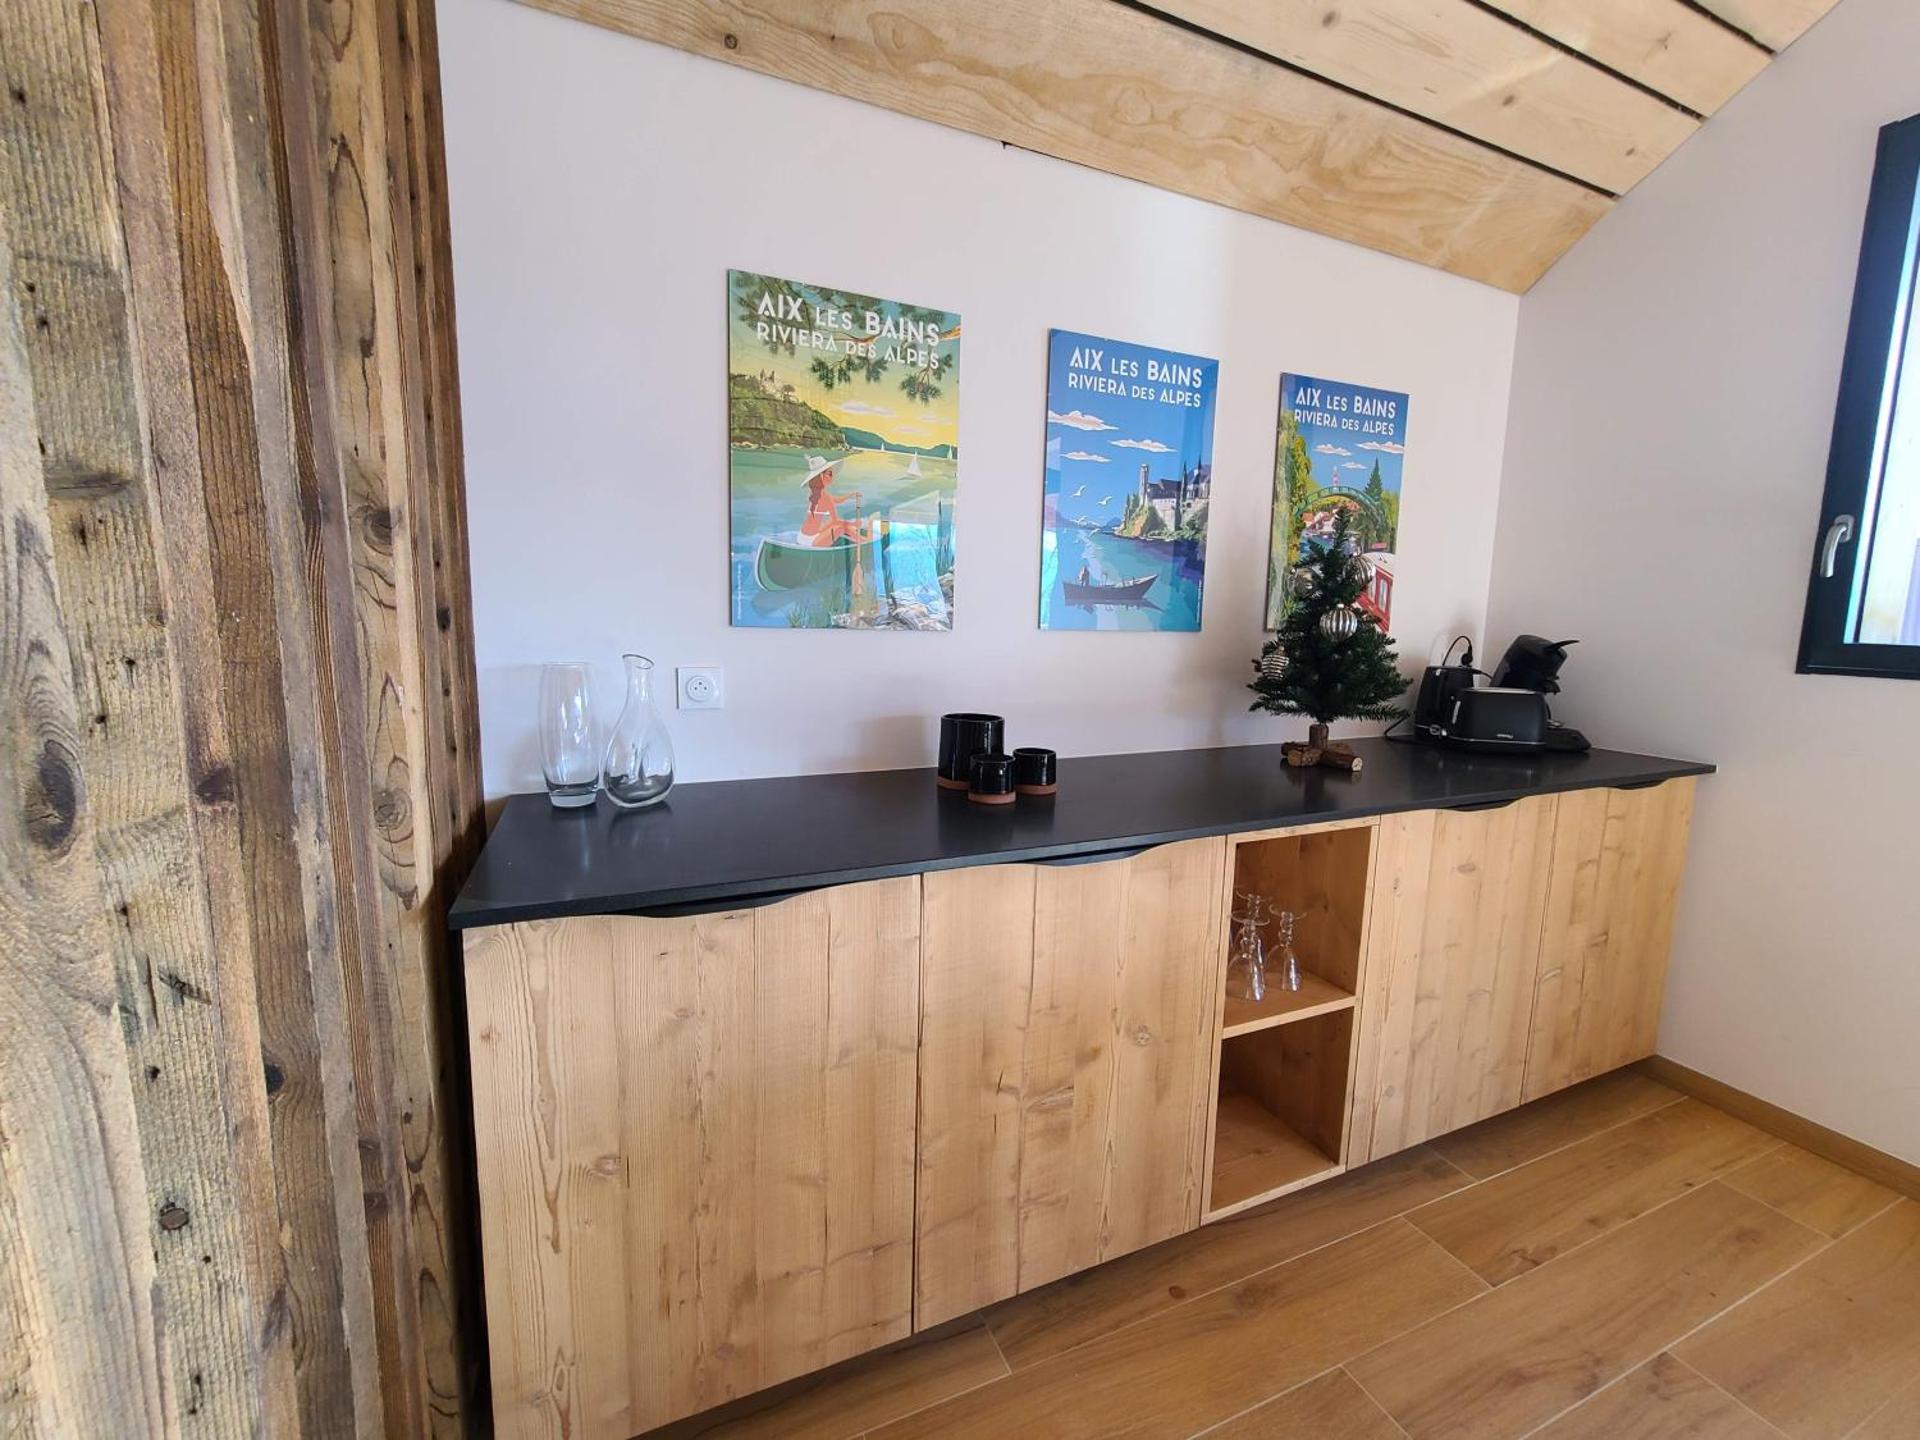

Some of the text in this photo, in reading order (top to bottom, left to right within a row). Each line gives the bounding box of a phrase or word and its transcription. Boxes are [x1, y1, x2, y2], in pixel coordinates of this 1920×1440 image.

[757, 291, 940, 347] AIX LES BAINS
[756, 321, 940, 370] RIVIERA DES ALPES
[1069, 346, 1203, 389] AIX LES BAINS
[1068, 372, 1202, 408] RIVIERA DES ALPES
[1295, 386, 1396, 419] AIX LES BAINS
[1294, 409, 1395, 436] RIVIERA DES ALPES
